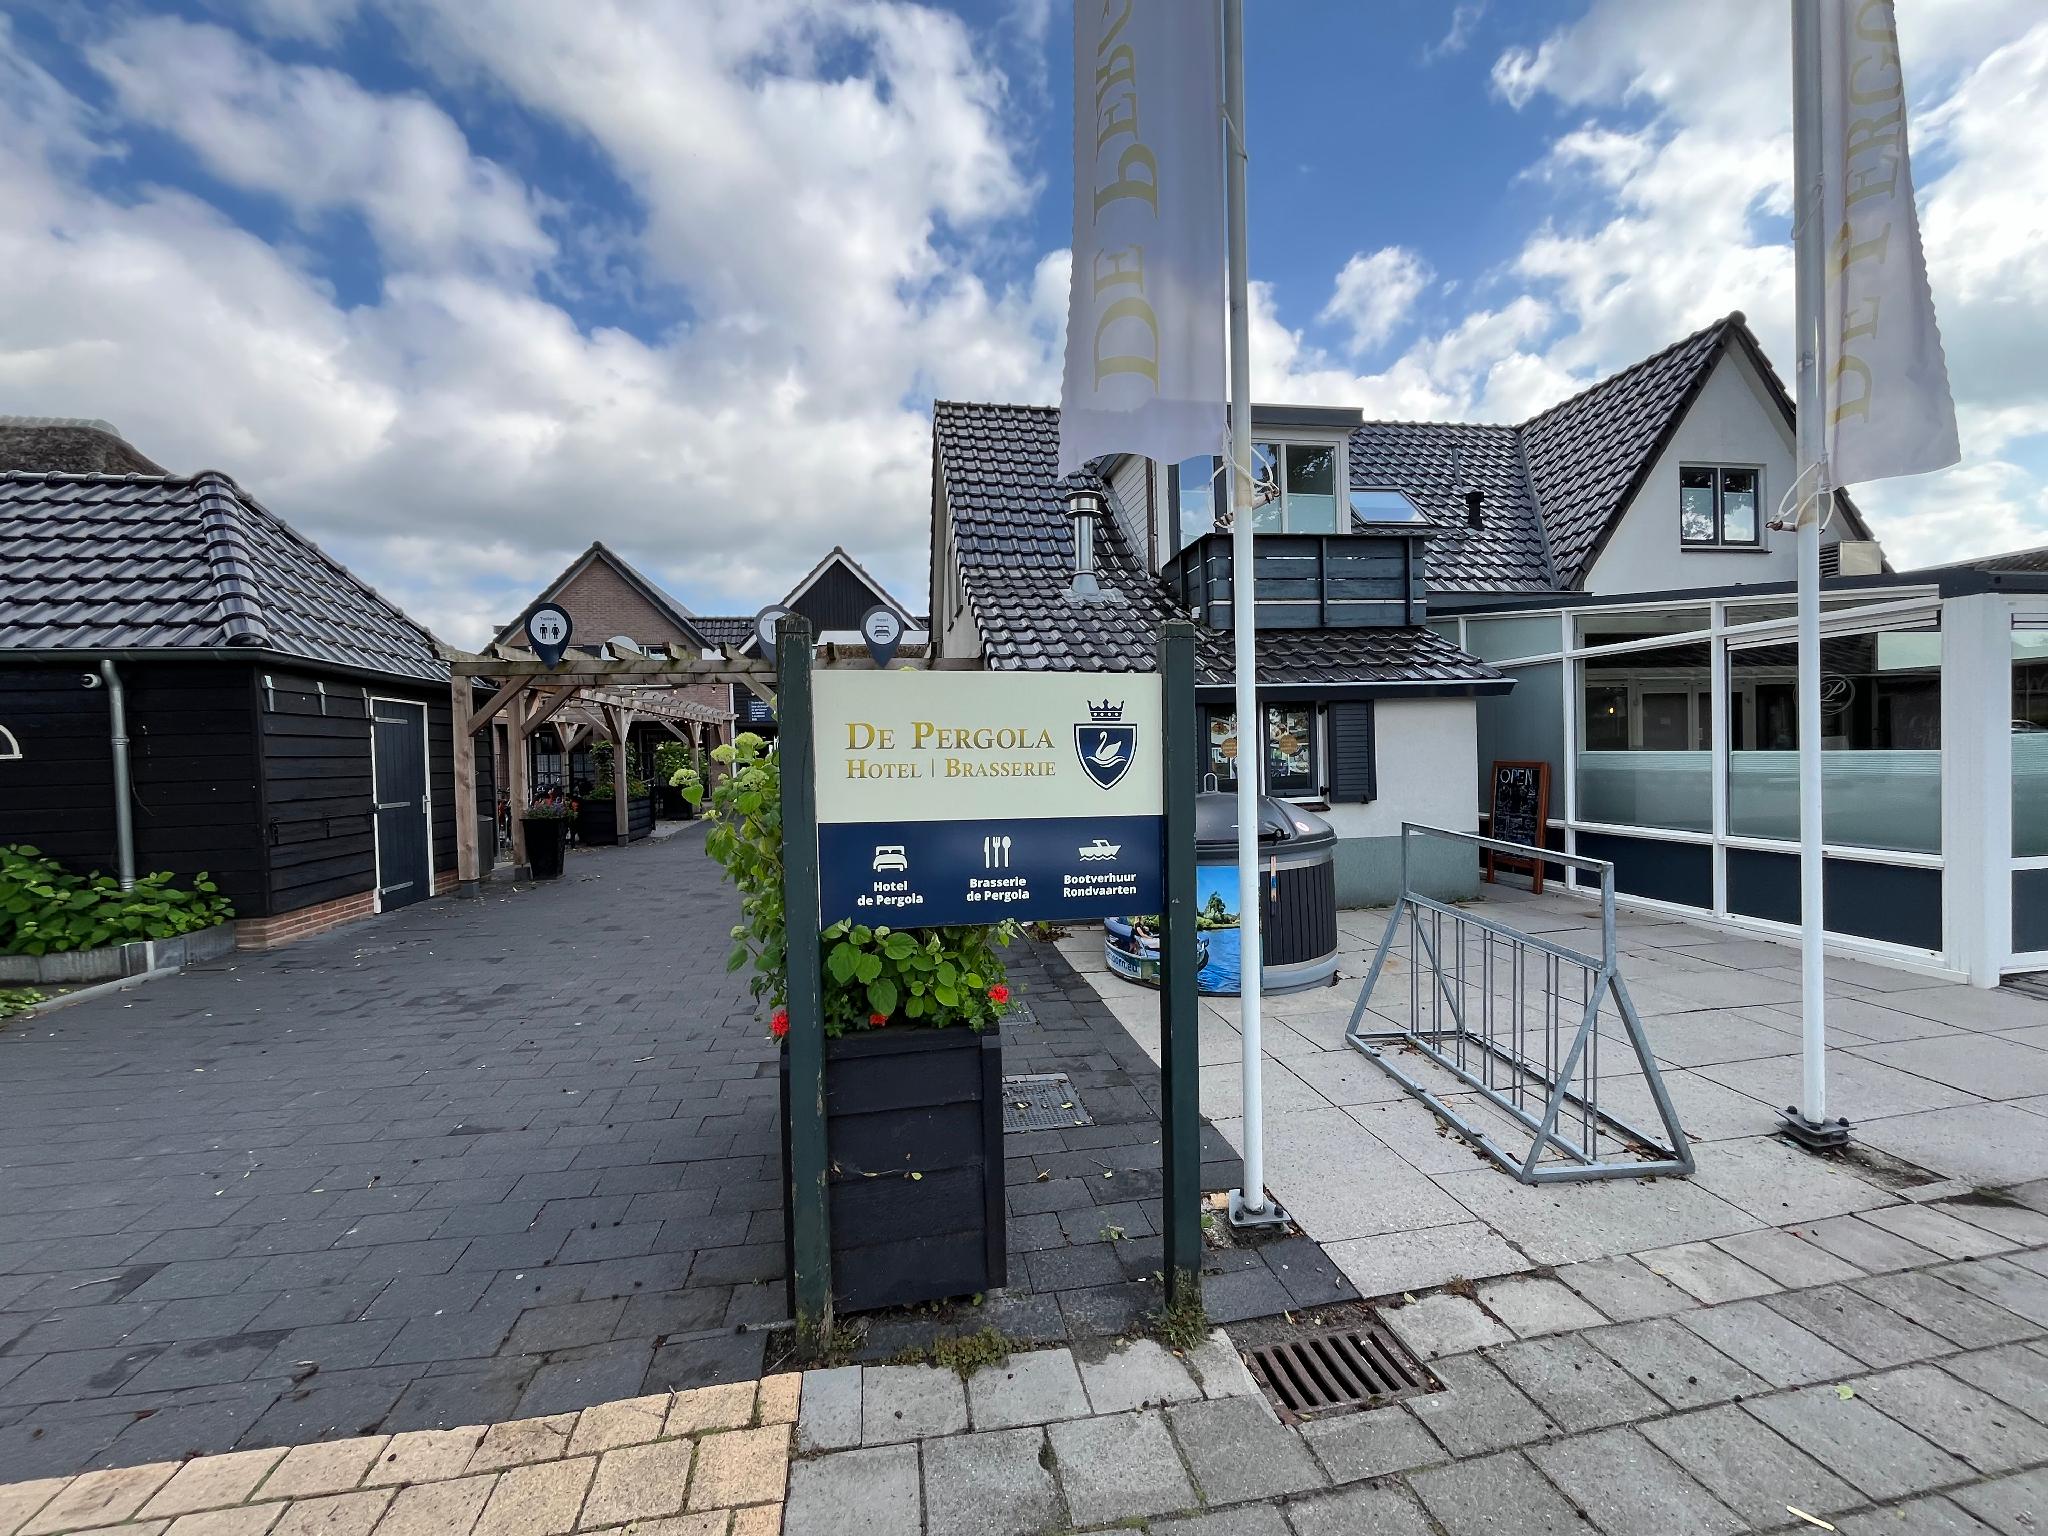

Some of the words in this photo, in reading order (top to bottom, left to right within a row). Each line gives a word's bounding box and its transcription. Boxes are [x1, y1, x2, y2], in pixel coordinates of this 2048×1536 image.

[845, 721, 895, 750] DE
[911, 721, 1056, 750] PERGOLA
[845, 758, 922, 779] HOTEL
[944, 758, 1056, 778] BRASSERIE
[1500, 768, 1533, 785] OPEN
[873, 880, 908, 892] Hotel
[969, 876, 1026, 889] Brasserie
[1063, 872, 1137, 885] Bootverhuur
[966, 889, 981, 901] de
[983, 888, 1030, 903] Pergola
[1063, 884, 1137, 898] Rondvaarten
[857, 895, 874, 906] de
[876, 893, 924, 908] Pergola
